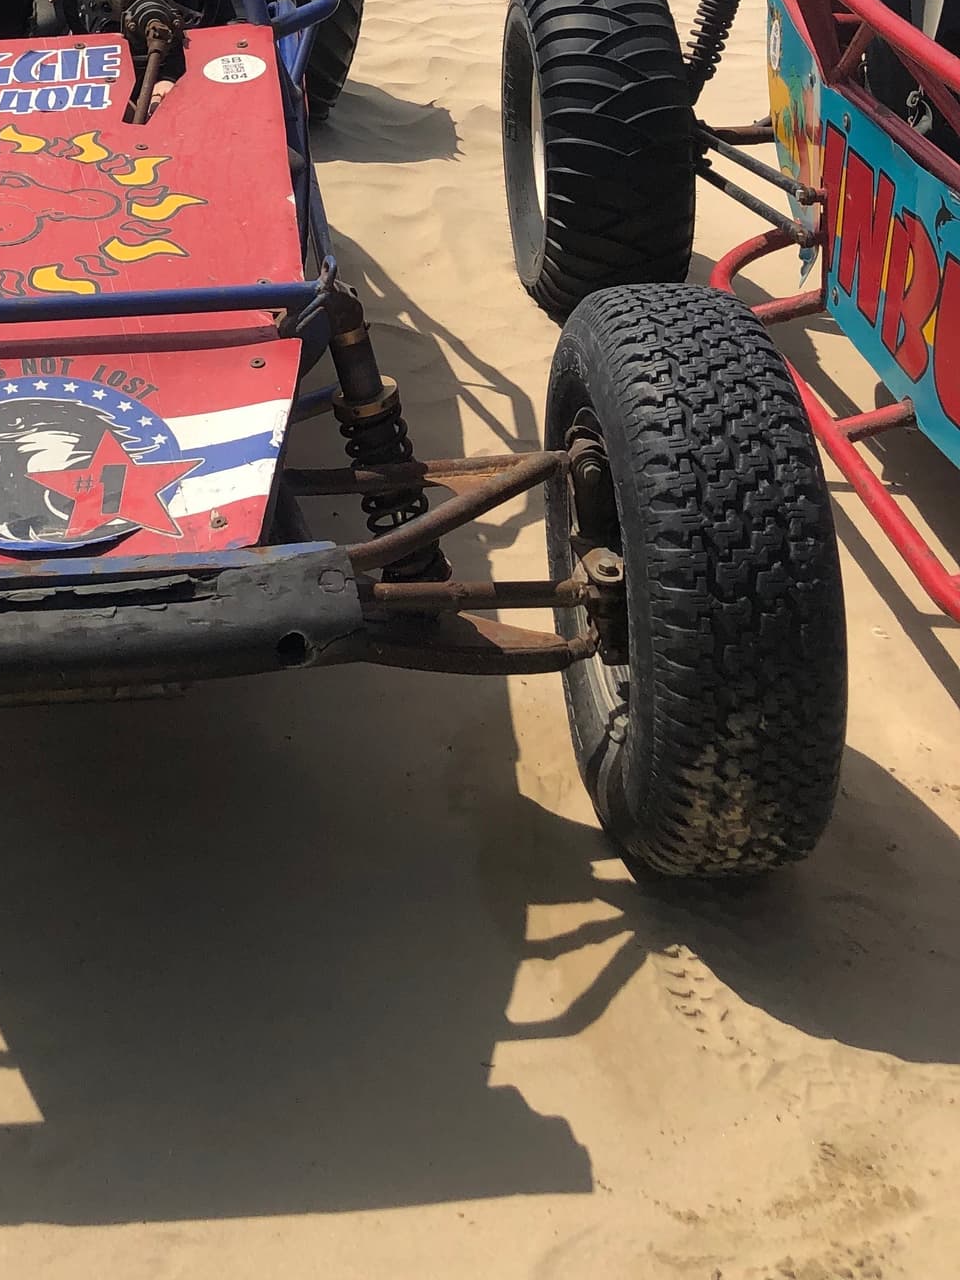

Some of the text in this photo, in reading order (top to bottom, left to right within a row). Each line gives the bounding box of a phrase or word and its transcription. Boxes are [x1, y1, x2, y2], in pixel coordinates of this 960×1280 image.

[22, 357, 75, 376] NOT
[92, 364, 159, 401] LOST
[76, 464, 127, 513] #1
